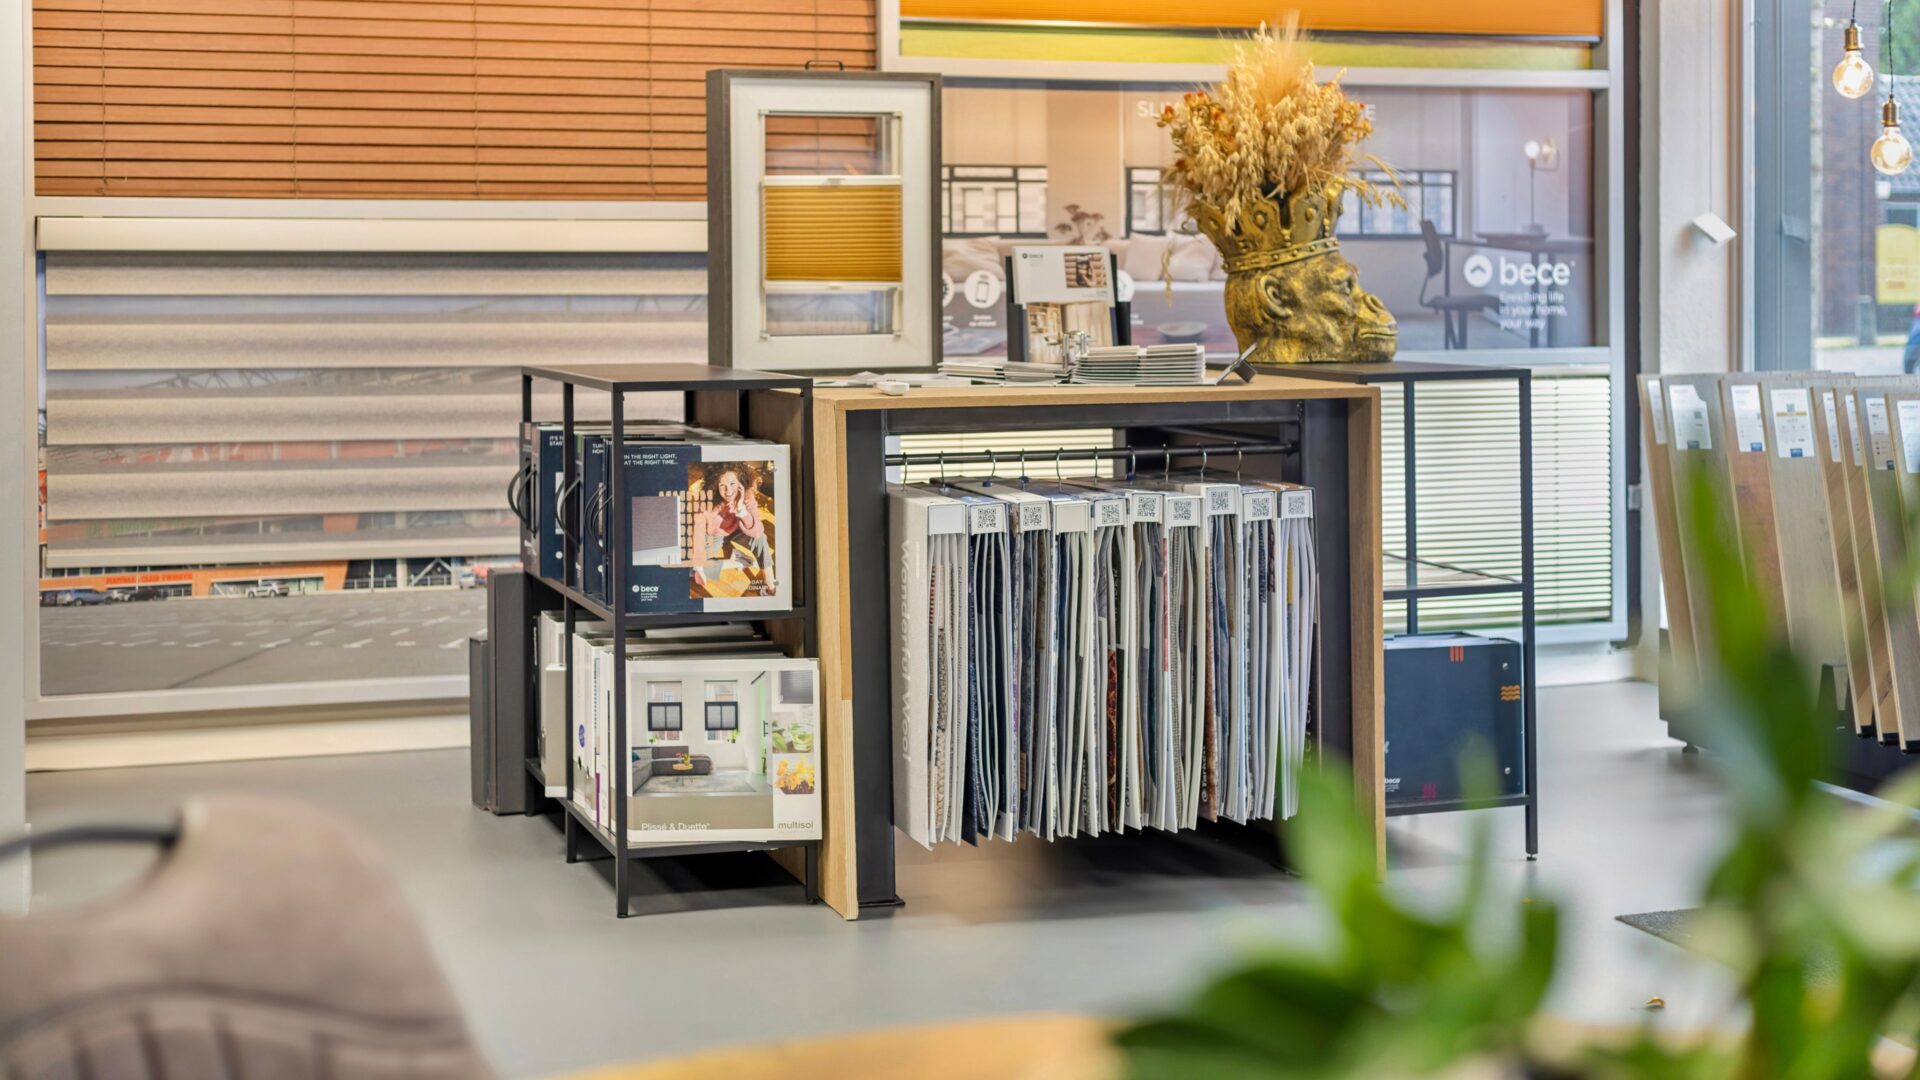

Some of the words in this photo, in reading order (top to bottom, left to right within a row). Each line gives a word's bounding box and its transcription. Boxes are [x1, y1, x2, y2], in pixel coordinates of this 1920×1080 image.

[1499, 256, 1570, 286] bece
[901, 540, 912, 681] Wonderful
[901, 691, 912, 762] Wool
[777, 821, 814, 829] multisol
